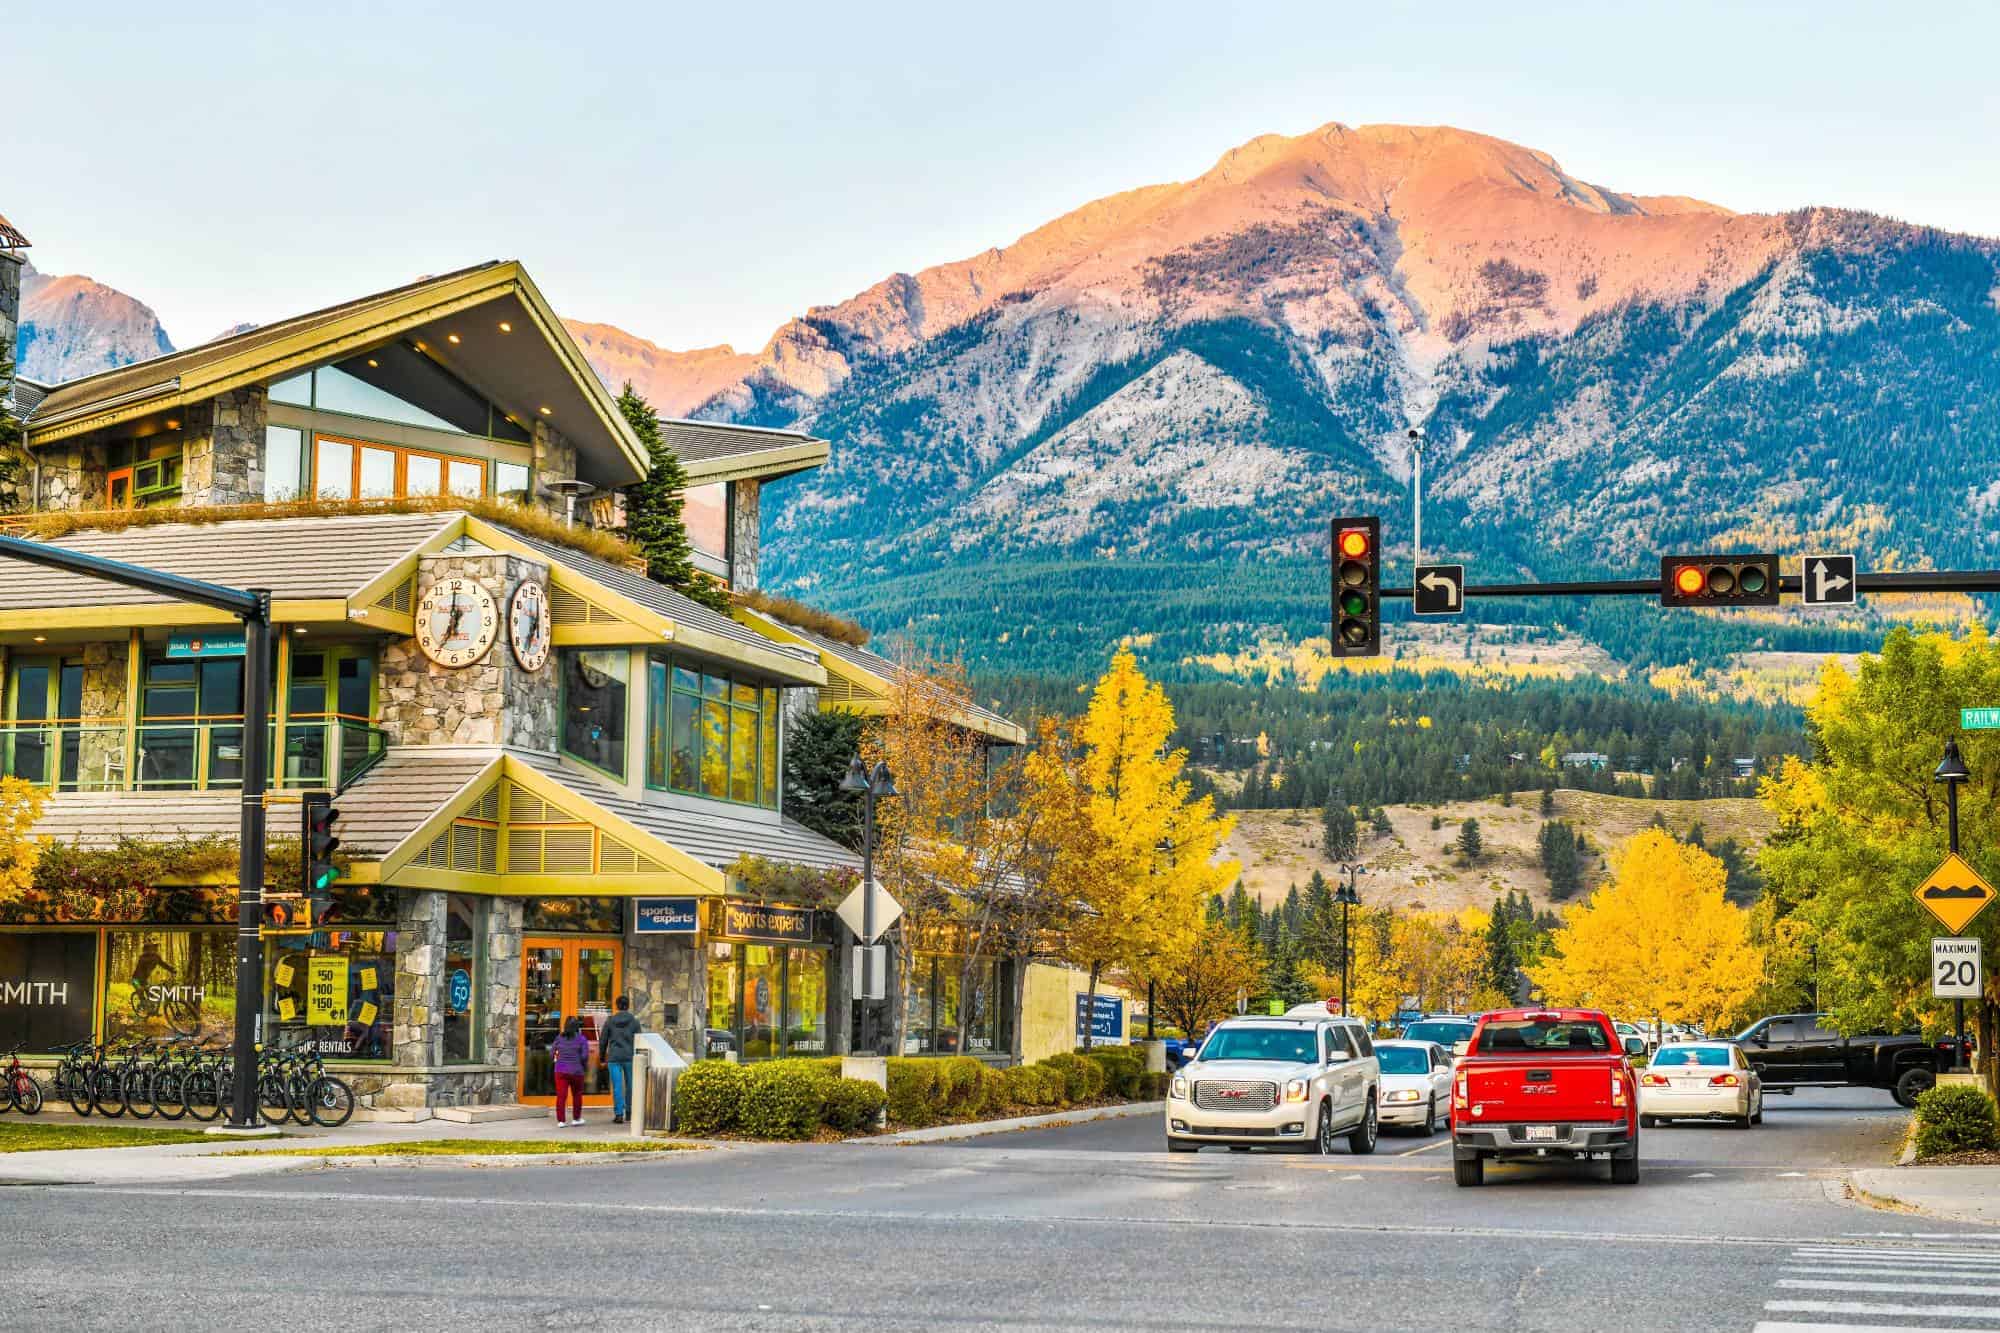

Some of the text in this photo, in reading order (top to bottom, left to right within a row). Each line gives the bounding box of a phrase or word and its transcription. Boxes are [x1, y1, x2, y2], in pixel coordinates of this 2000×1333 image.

[450, 581, 462, 590] 12
[472, 585, 476, 595] 1
[434, 586, 443, 596] 11
[423, 600, 433, 610] 10
[482, 598, 489, 608] 2
[419, 617, 425, 626] 9
[484, 615, 491, 626] 3
[423, 636, 429, 646] 8
[480, 634, 486, 645] 4
[434, 649, 440, 659] 7
[451, 653, 458, 663] 6
[468, 648, 475, 658] 5
[1966, 710, 2000, 726] RAILW
[640, 906, 675, 916] sports
[653, 914, 694, 925] experts
[733, 911, 805, 935] sports experts
[1935, 944, 1977, 954] MAXIMUM
[318, 970, 333, 981] $50
[1937, 960, 1976, 986] 20
[149, 986, 205, 1002] SMITH
[313, 984, 333, 995] $100
[313, 998, 333, 1008] $150
[320, 1040, 352, 1053] RENTALS
